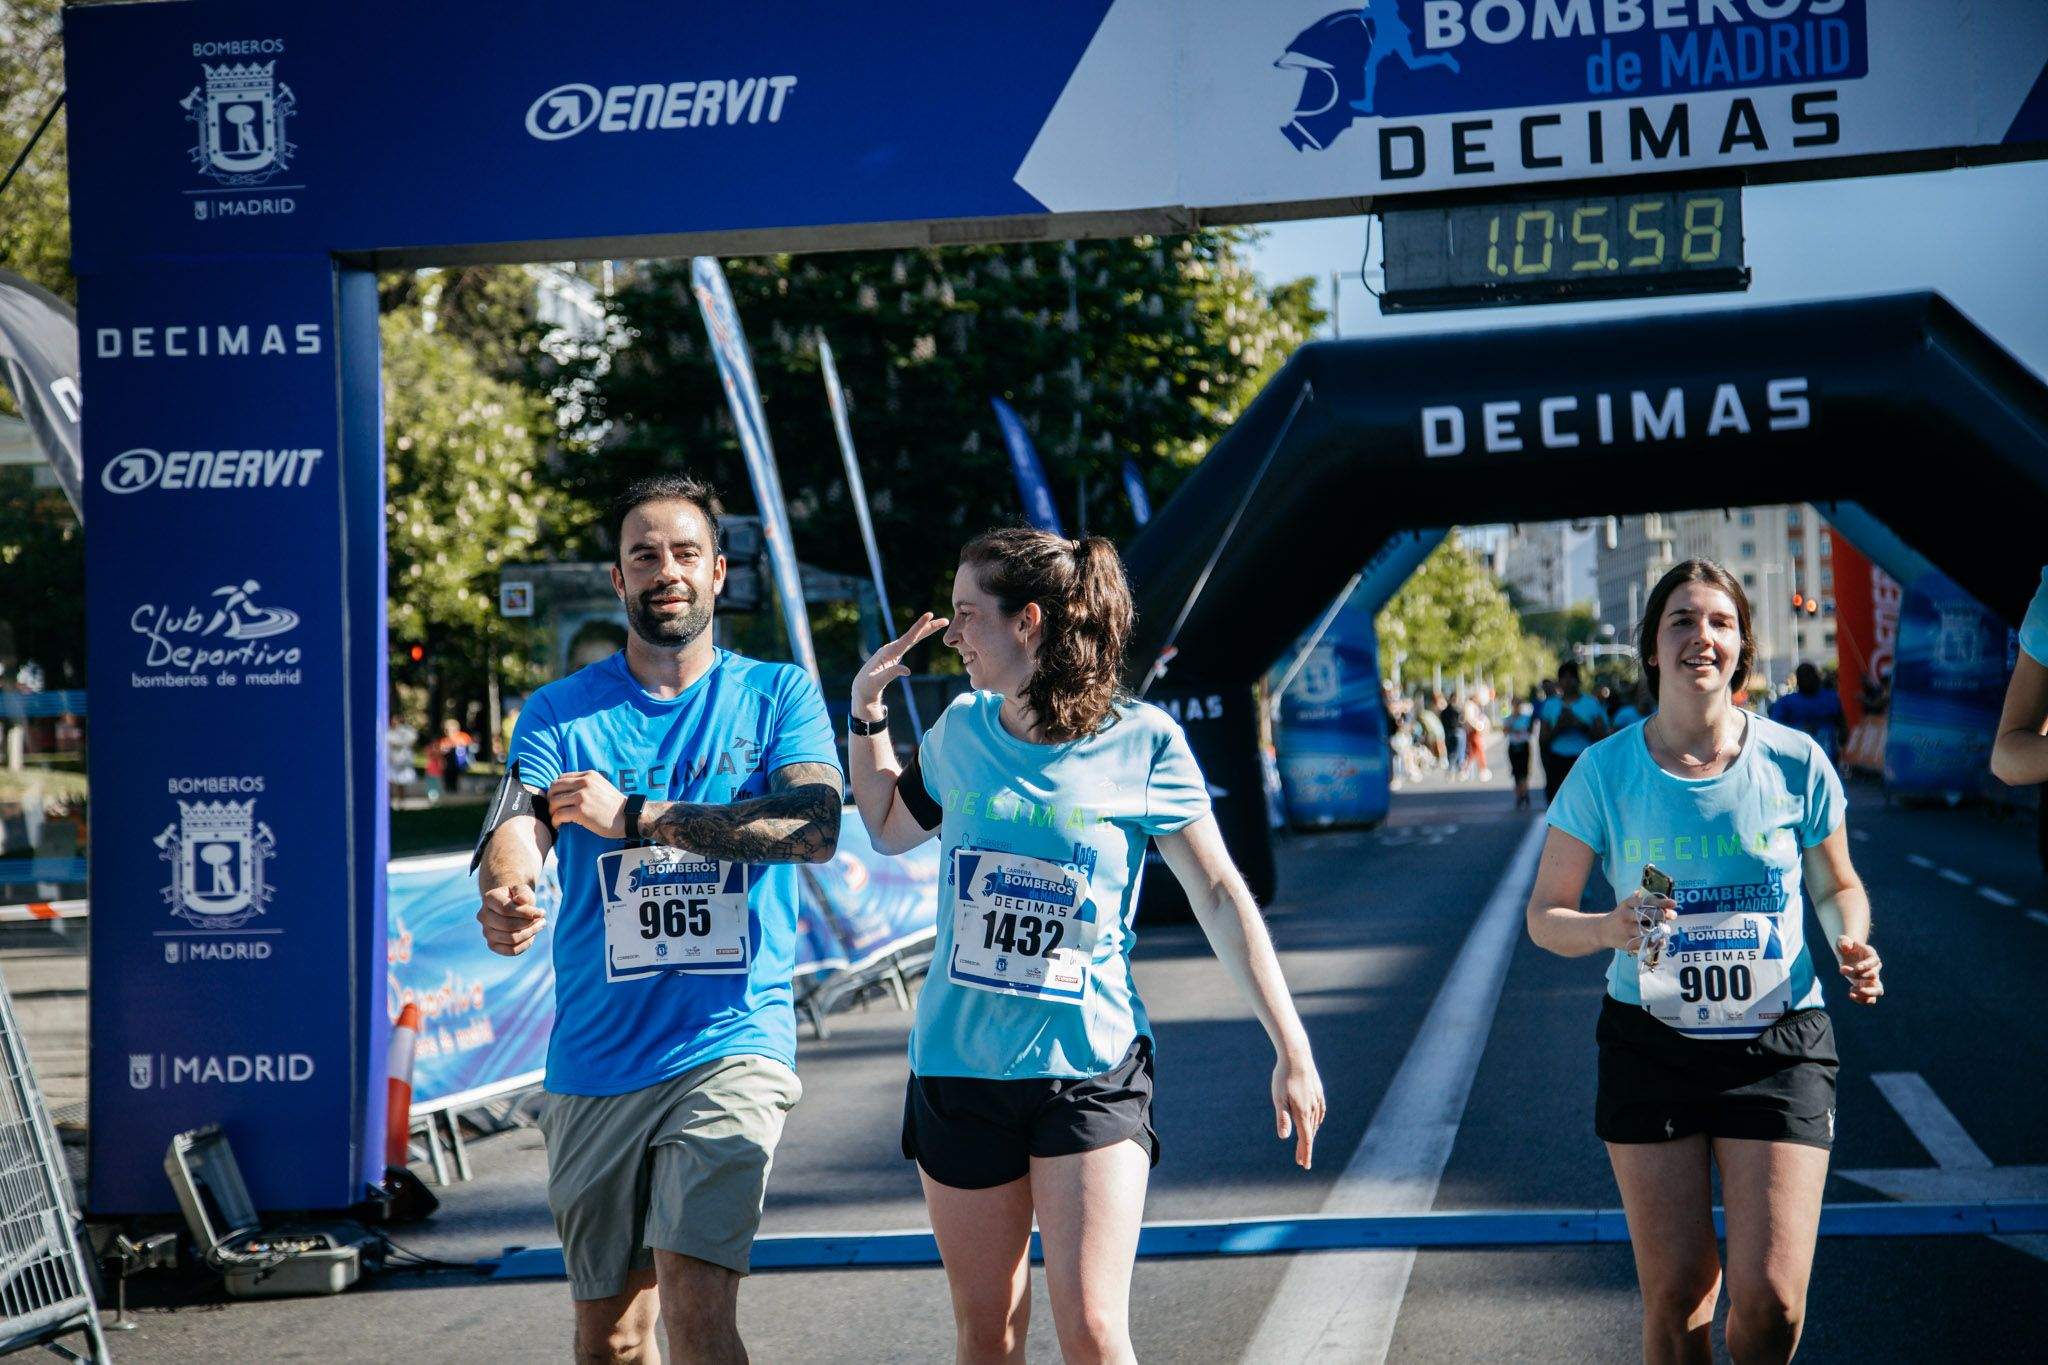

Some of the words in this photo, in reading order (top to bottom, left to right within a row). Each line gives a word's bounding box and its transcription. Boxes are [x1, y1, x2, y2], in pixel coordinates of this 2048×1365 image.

[192, 39, 284, 57] BOMBEROS
[1587, 41, 1642, 95] de
[1660, 18, 1850, 88] MADRID
[599, 75, 798, 132] ENERVIT
[1378, 90, 1841, 181] DECIMAS
[218, 198, 296, 216] MADRID
[97, 323, 321, 358] DECIMAS
[1422, 378, 1812, 457] DECIMAS
[161, 449, 323, 489] ENERVIT
[131, 604, 203, 634] Club
[146, 632, 301, 673] Deportivo
[131, 672, 208, 688] bomberos
[216, 671, 237, 686] de
[245, 668, 301, 685] madrid
[168, 776, 266, 794] BOMBEROS
[648, 862, 717, 875] BOMBEROS
[642, 884, 716, 898] DECIMAS
[1004, 874, 1074, 897] BOMBEROS
[1674, 882, 1781, 905] BOMBEROS
[639, 898, 711, 940] 965
[994, 895, 1068, 919] DECIMAS
[983, 910, 1065, 961] 1432
[1687, 929, 1757, 942] BOMBEROS
[190, 942, 272, 961] MADRID
[1681, 950, 1757, 963] DECIMAS
[1680, 964, 1752, 1003] 900
[173, 1054, 314, 1084] MADRID
